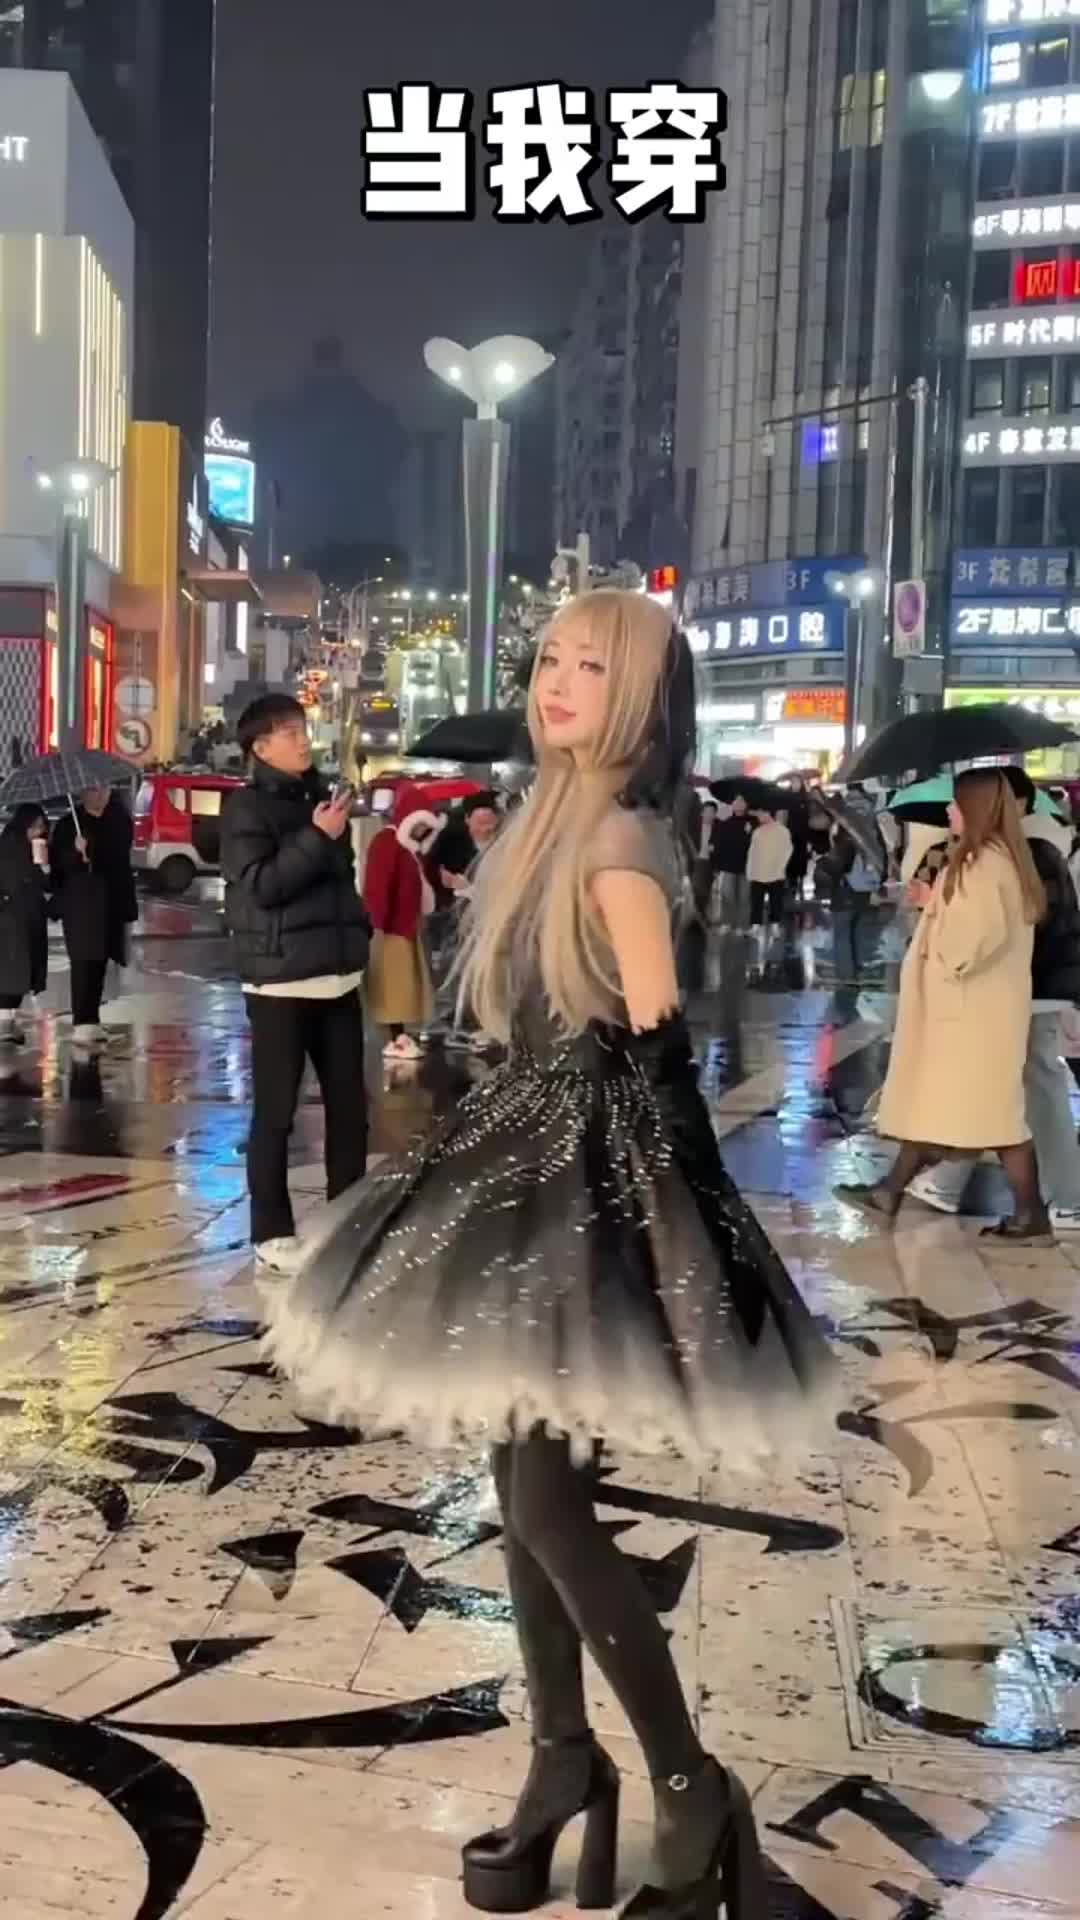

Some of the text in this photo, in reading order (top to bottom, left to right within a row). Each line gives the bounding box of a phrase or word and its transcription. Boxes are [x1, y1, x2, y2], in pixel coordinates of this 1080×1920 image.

[964, 431, 991, 455] 4F
[786, 569, 811, 592] 3F
[957, 560, 980, 583] 3F
